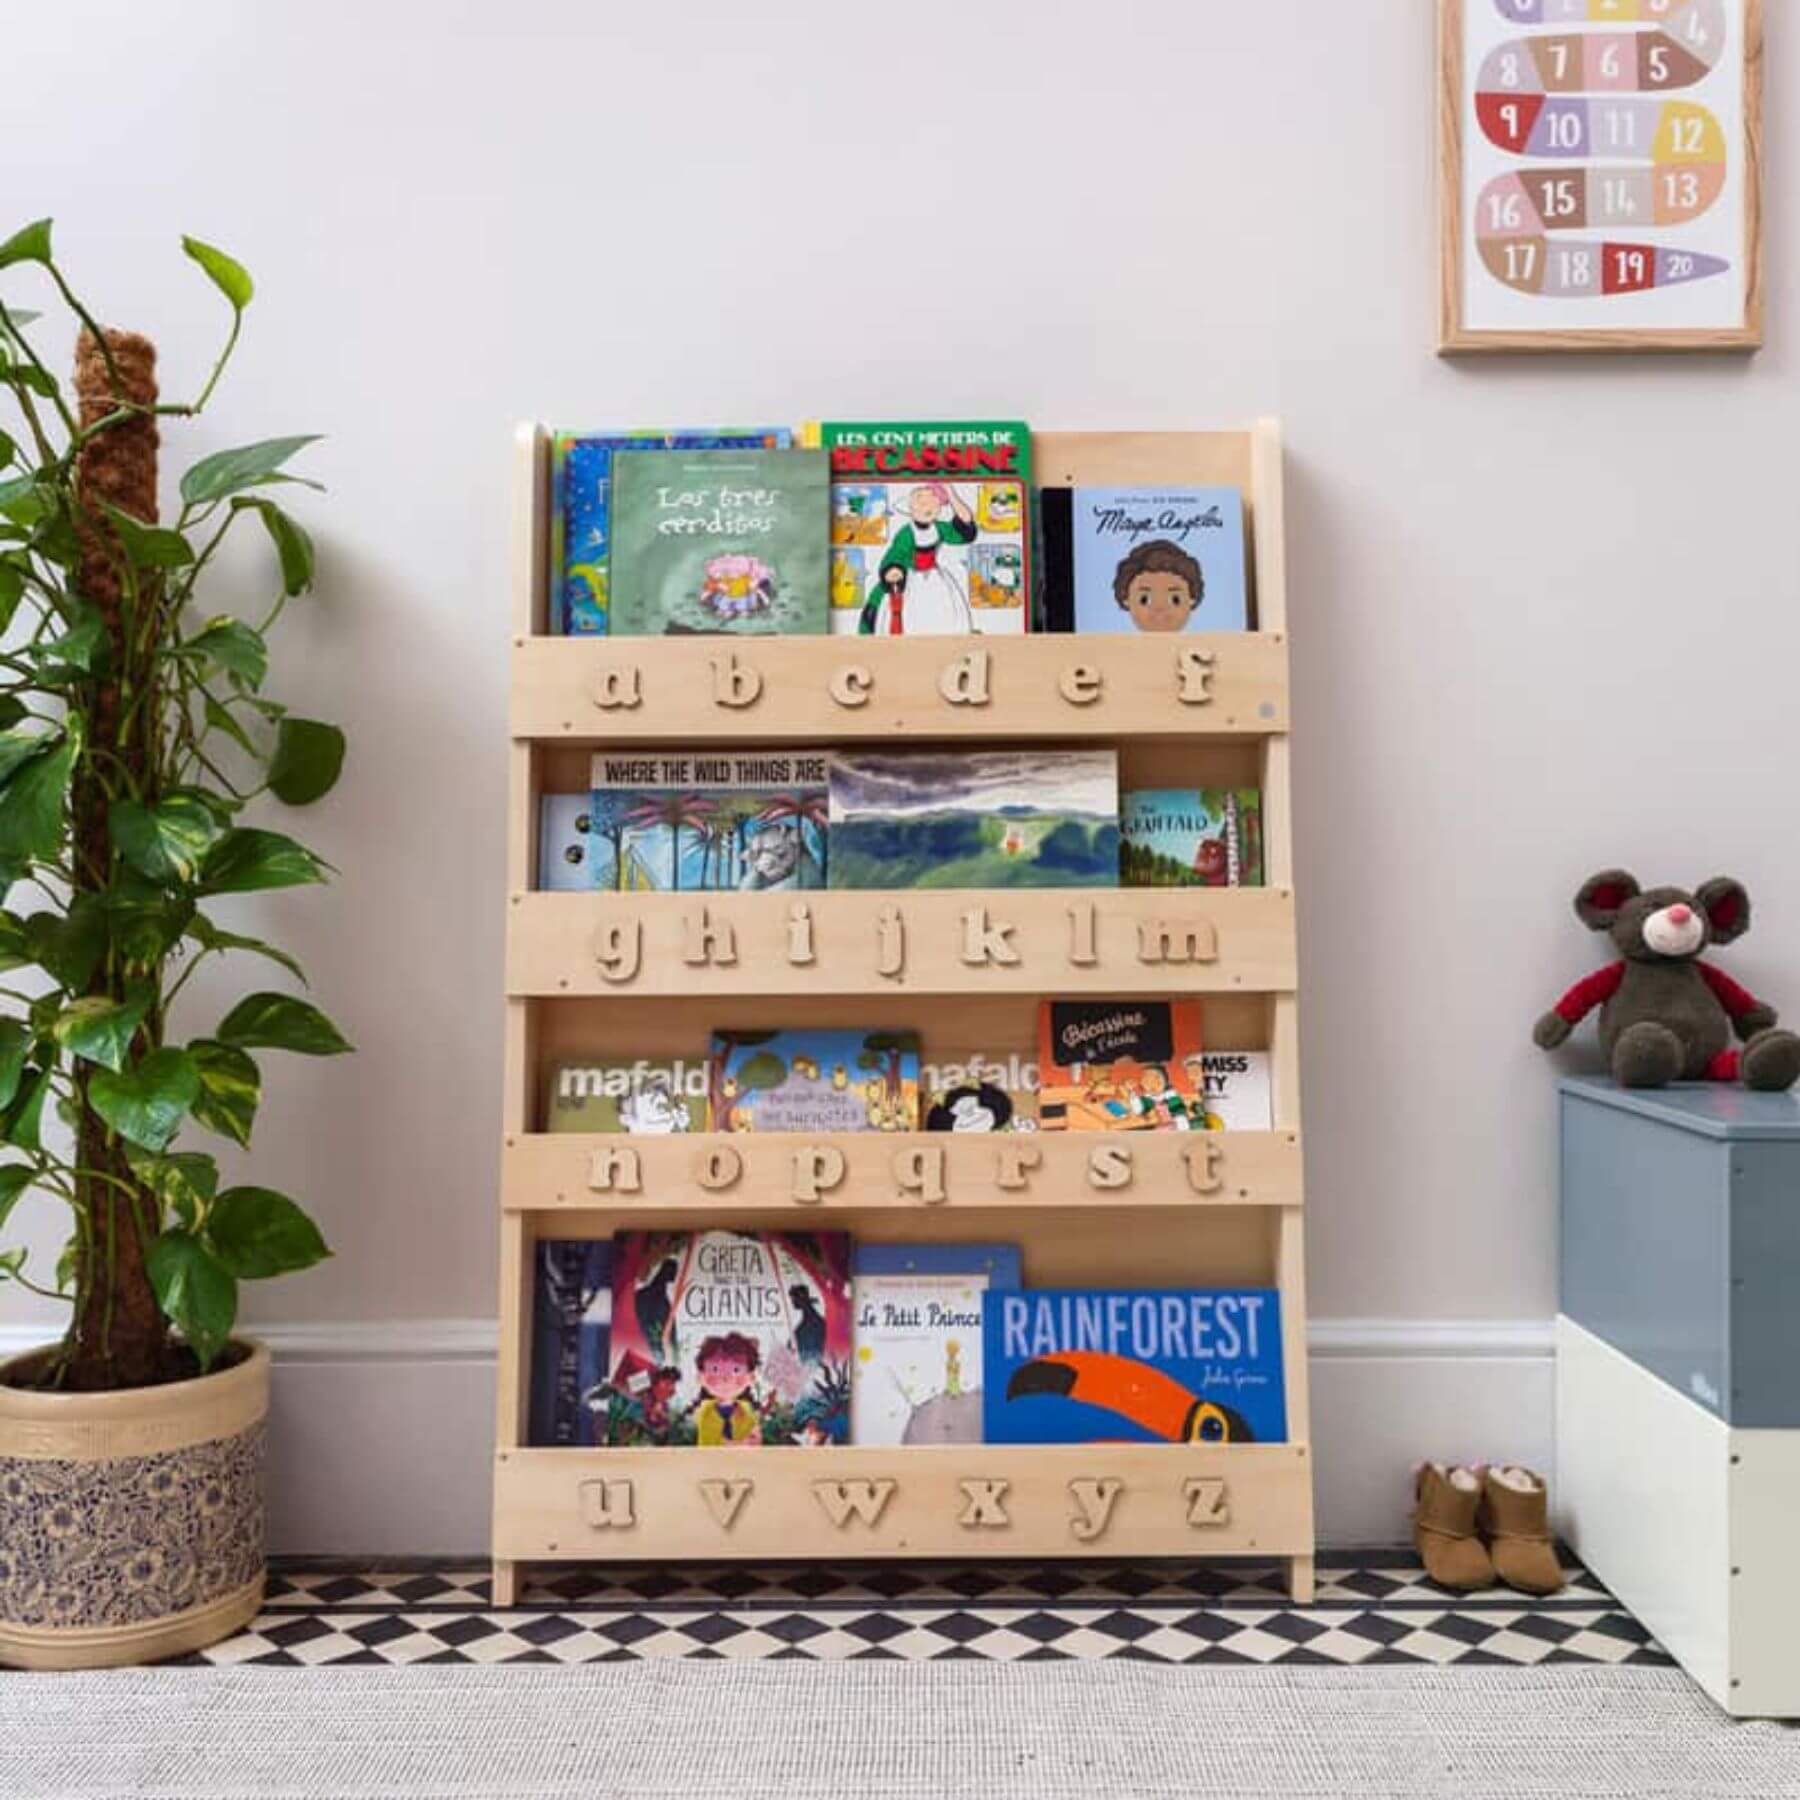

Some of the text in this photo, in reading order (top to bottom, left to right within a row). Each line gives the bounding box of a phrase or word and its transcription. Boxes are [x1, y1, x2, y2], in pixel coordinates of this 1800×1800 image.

[1500, 41, 1669, 87] 8 7 6 5
[1499, 104, 1704, 154] 9 10 11 12
[1487, 174, 1698, 229] 16 15 14 13
[1504, 244, 1693, 288] 17 18 19 20
[594, 647, 1215, 711] a b c d e f
[604, 758, 826, 784] WHERE THE WILD THINGS ARE
[594, 902, 1221, 986] g h i j k l m
[1202, 1056, 1248, 1074] MISS
[588, 1140, 1224, 1204] n o p q r s t
[698, 1243, 763, 1275] GRETA
[684, 1284, 780, 1320] GIANTS
[858, 1301, 980, 1326] Le Petit Prince
[1003, 1296, 1263, 1359] RAINFOREST
[578, 1477, 1230, 1541] u v w x y z
